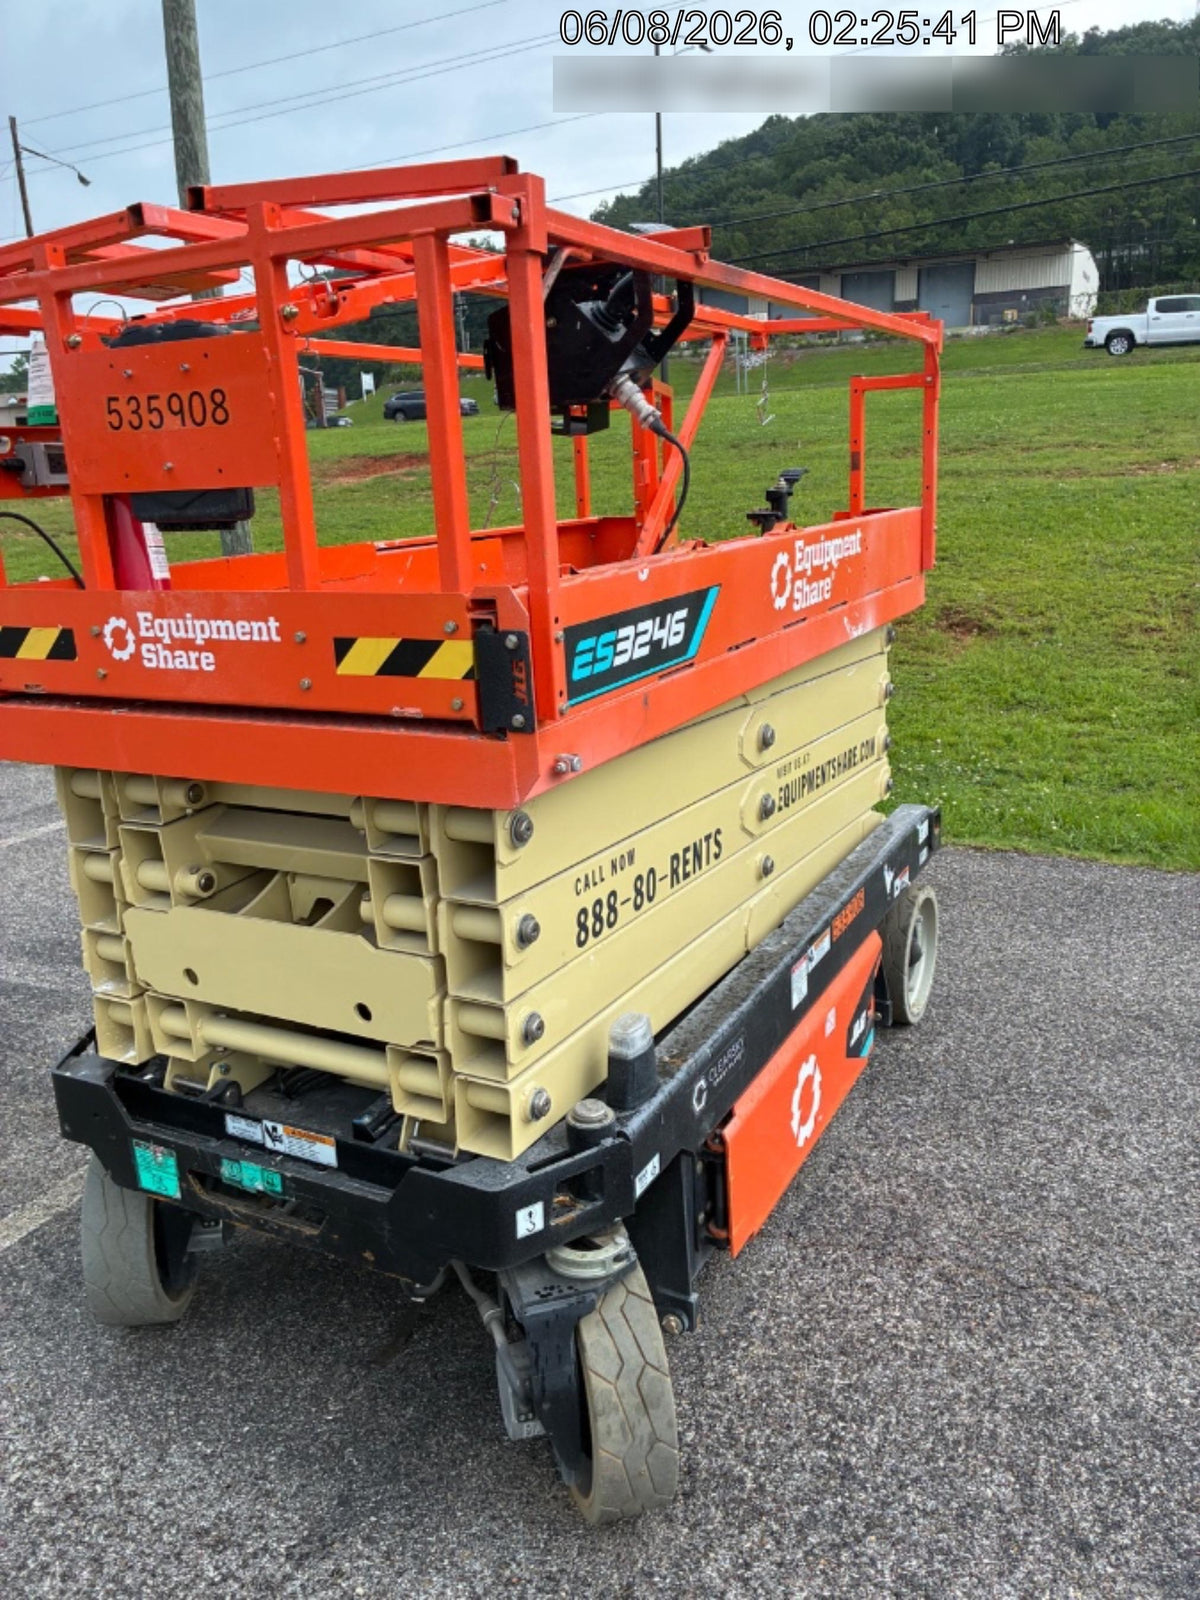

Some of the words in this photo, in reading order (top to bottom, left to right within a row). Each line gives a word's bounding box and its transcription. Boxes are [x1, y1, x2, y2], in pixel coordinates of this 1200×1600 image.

[106, 388, 231, 431] 535908
[793, 528, 862, 576] Equipment
[792, 577, 832, 612] Share
[136, 611, 281, 645] Equipment
[571, 608, 688, 682] ES3246
[141, 643, 216, 671] Share
[777, 736, 876, 813] EQUIPMENTSHARE.COM
[575, 865, 605, 896] CALL
[610, 847, 636, 876] NOW
[575, 827, 723, 949] 888-80-RENTS
